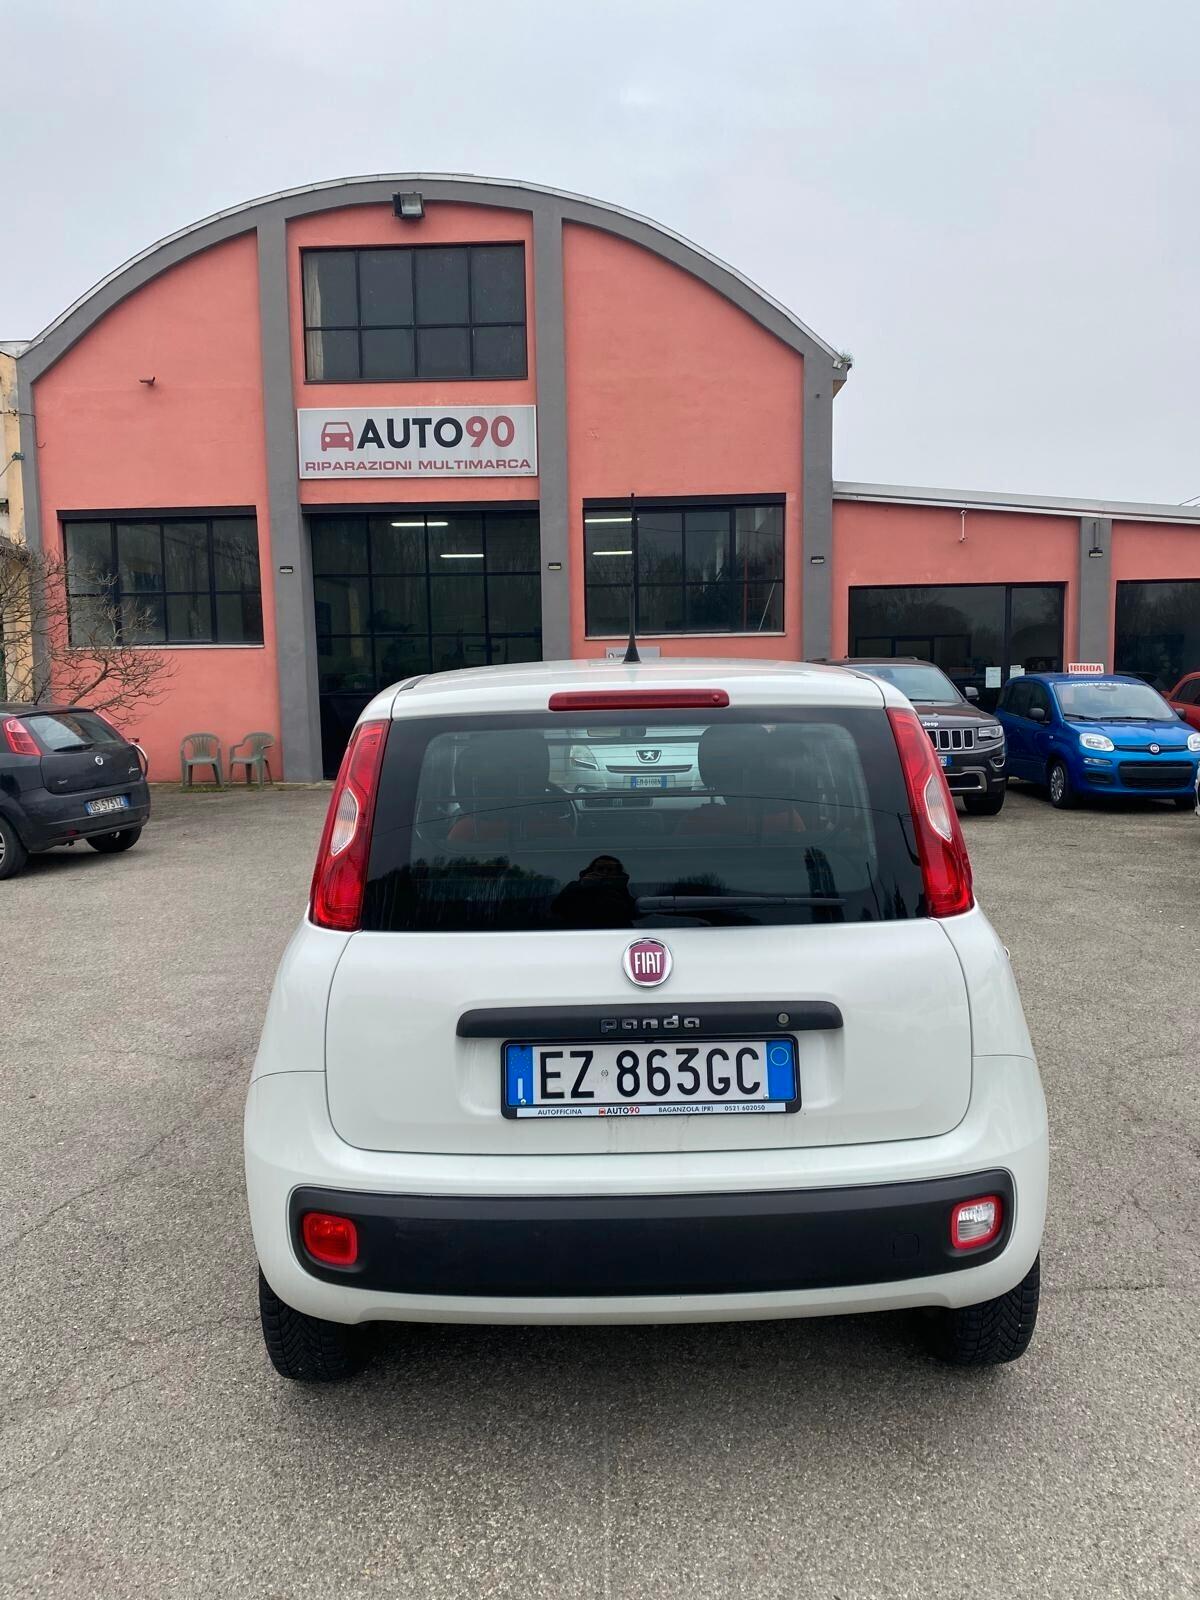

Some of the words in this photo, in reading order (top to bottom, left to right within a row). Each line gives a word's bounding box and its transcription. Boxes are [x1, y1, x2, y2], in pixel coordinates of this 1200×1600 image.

[357, 415, 515, 449] AUTO90
[305, 460, 412, 472] RIPARAZIONI
[418, 458, 531, 470] MULTIMARCA
[1070, 664, 1102, 672] IBRIDA
[634, 951, 663, 975] FIAT
[600, 1014, 701, 1033] panda
[539, 1050, 595, 1100] EZ
[616, 1047, 761, 1098] 863GC
[537, 1108, 583, 1116] AUTOFFICINA
[606, 1106, 640, 1115] AUTO90
[658, 1105, 700, 1113] BAGANZOLA
[701, 1105, 714, 1113] (PR)
[724, 1104, 740, 1112] 0521
[741, 1103, 766, 1111] 602050
